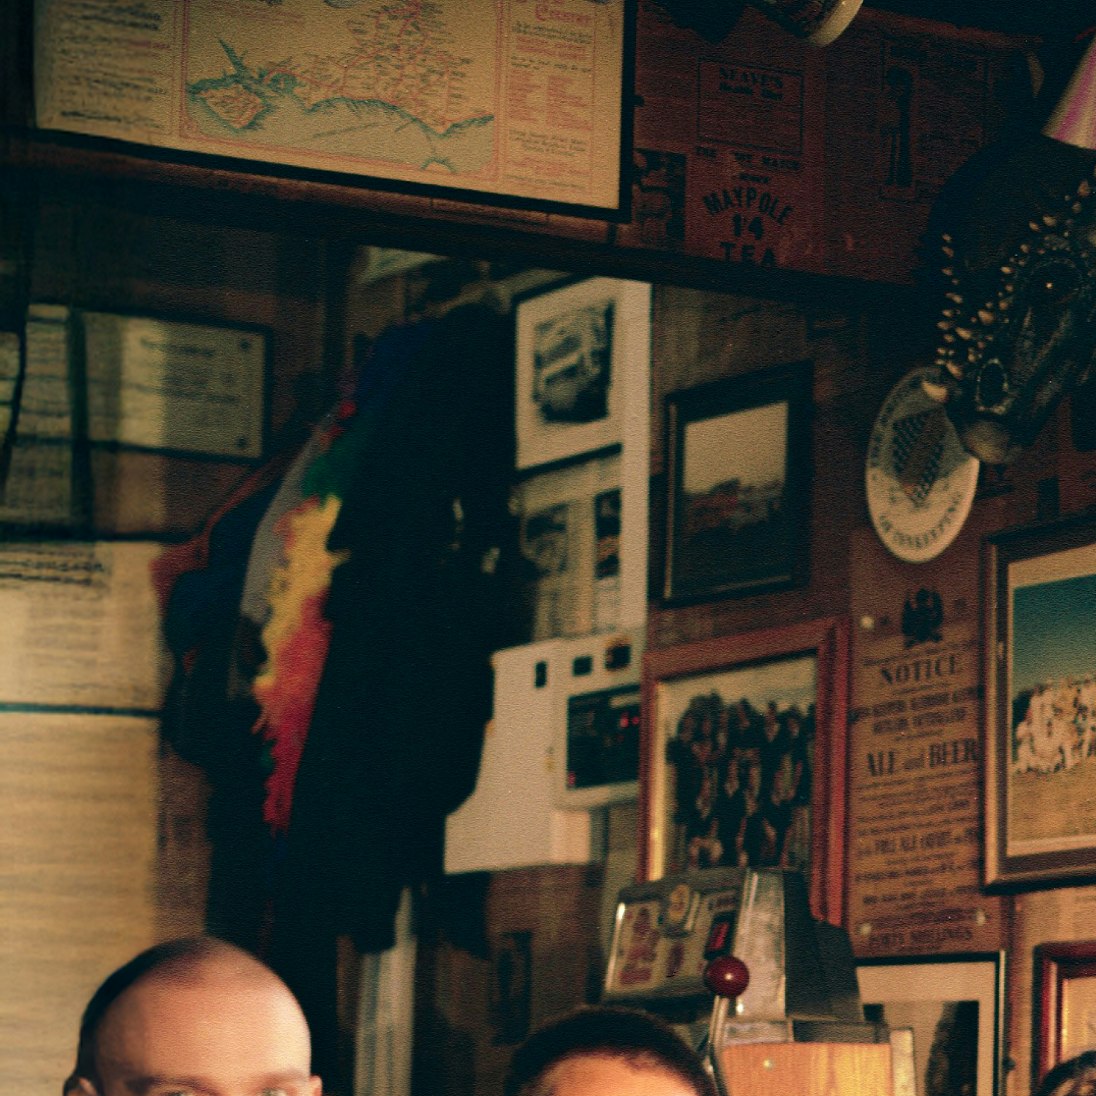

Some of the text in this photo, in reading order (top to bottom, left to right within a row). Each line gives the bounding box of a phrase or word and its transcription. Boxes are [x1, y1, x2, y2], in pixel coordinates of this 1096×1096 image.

[702, 186, 793, 226] MAYPOLE
[719, 241, 777, 266] TEA
[880, 653, 963, 686] NOTICE
[929, 738, 979, 768] BEER
